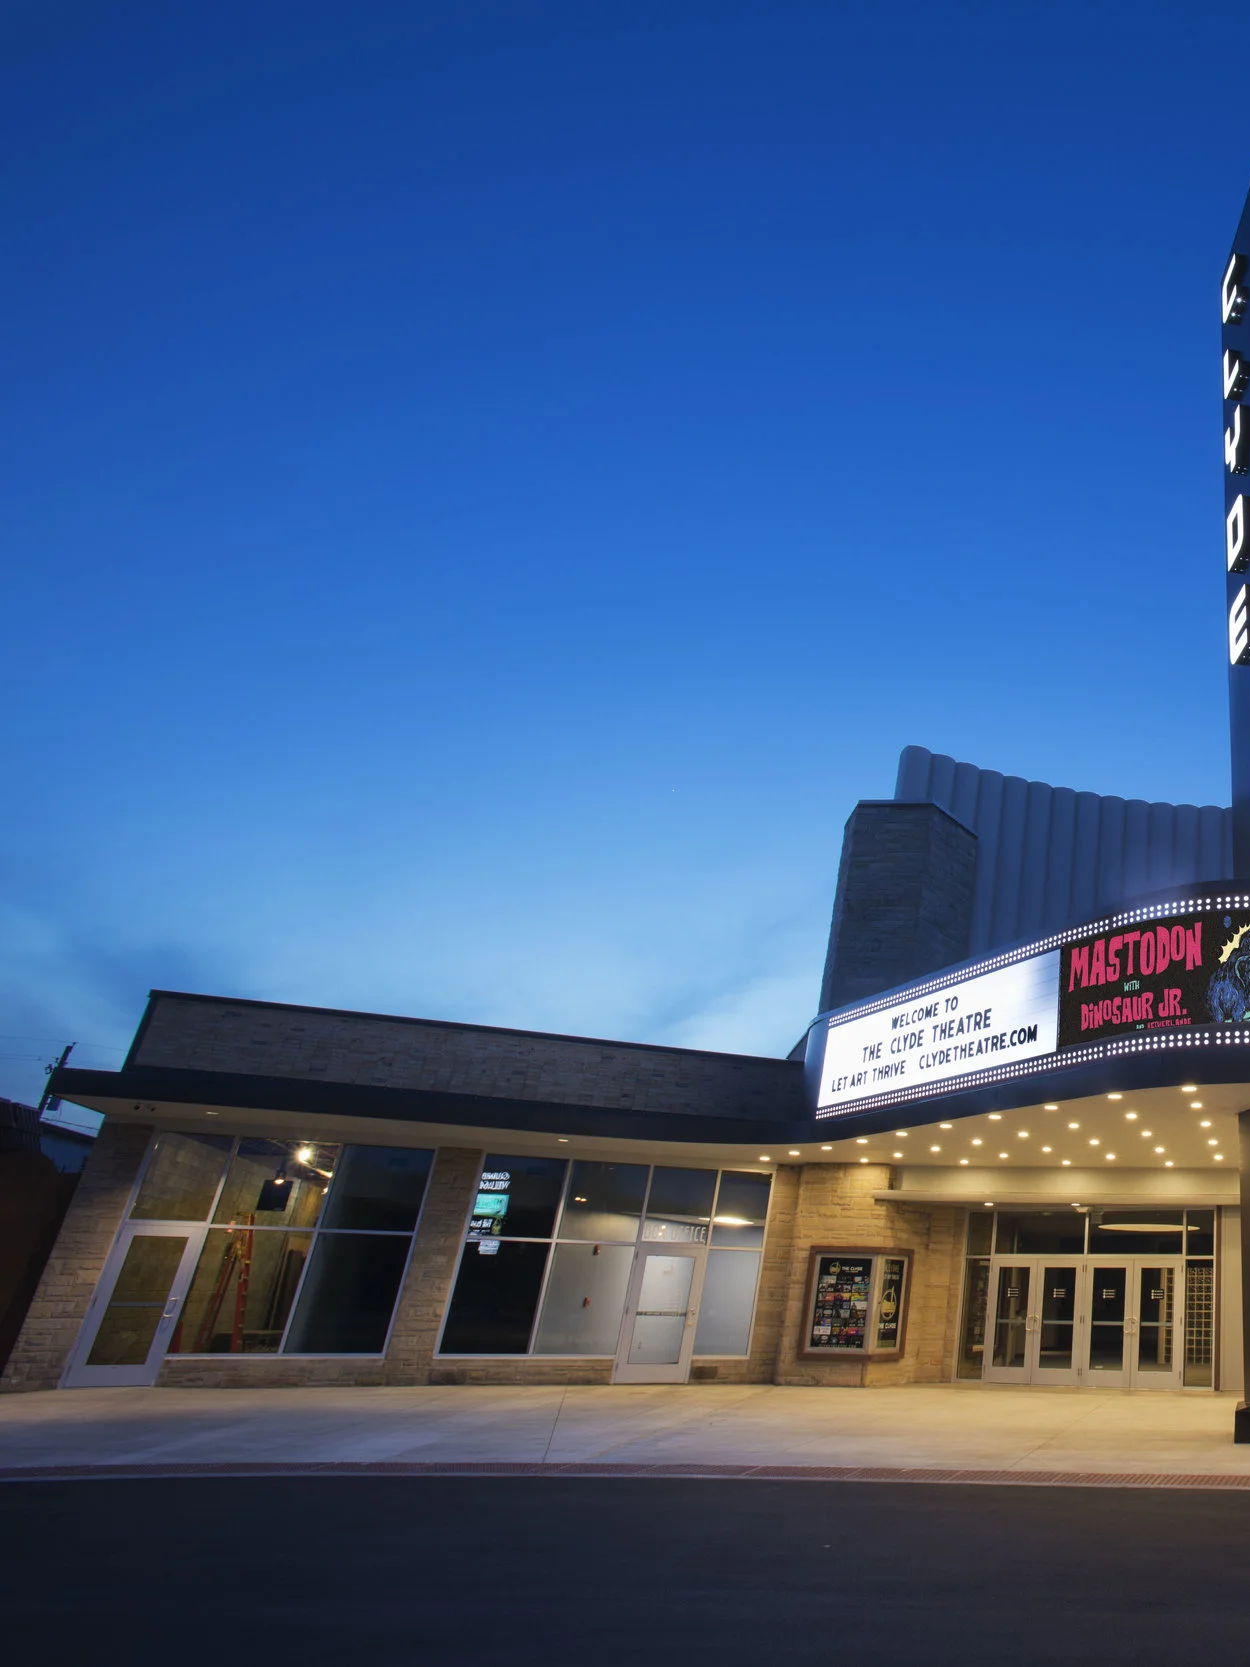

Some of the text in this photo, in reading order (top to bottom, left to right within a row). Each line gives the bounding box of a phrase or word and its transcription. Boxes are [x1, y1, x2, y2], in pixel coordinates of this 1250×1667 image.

[1221, 253, 1249, 666] CLYDE
[1068, 920, 1203, 993] MASTODON
[891, 996, 959, 1030] WELCOME TO
[1123, 980, 1140, 992] WITH
[1157, 988, 1187, 1018] JR.
[831, 1023, 1038, 1093] LET ART THRIVE CLYDETHEATRE.COM
[862, 1008, 992, 1063] THE CLYDE THEATRE
